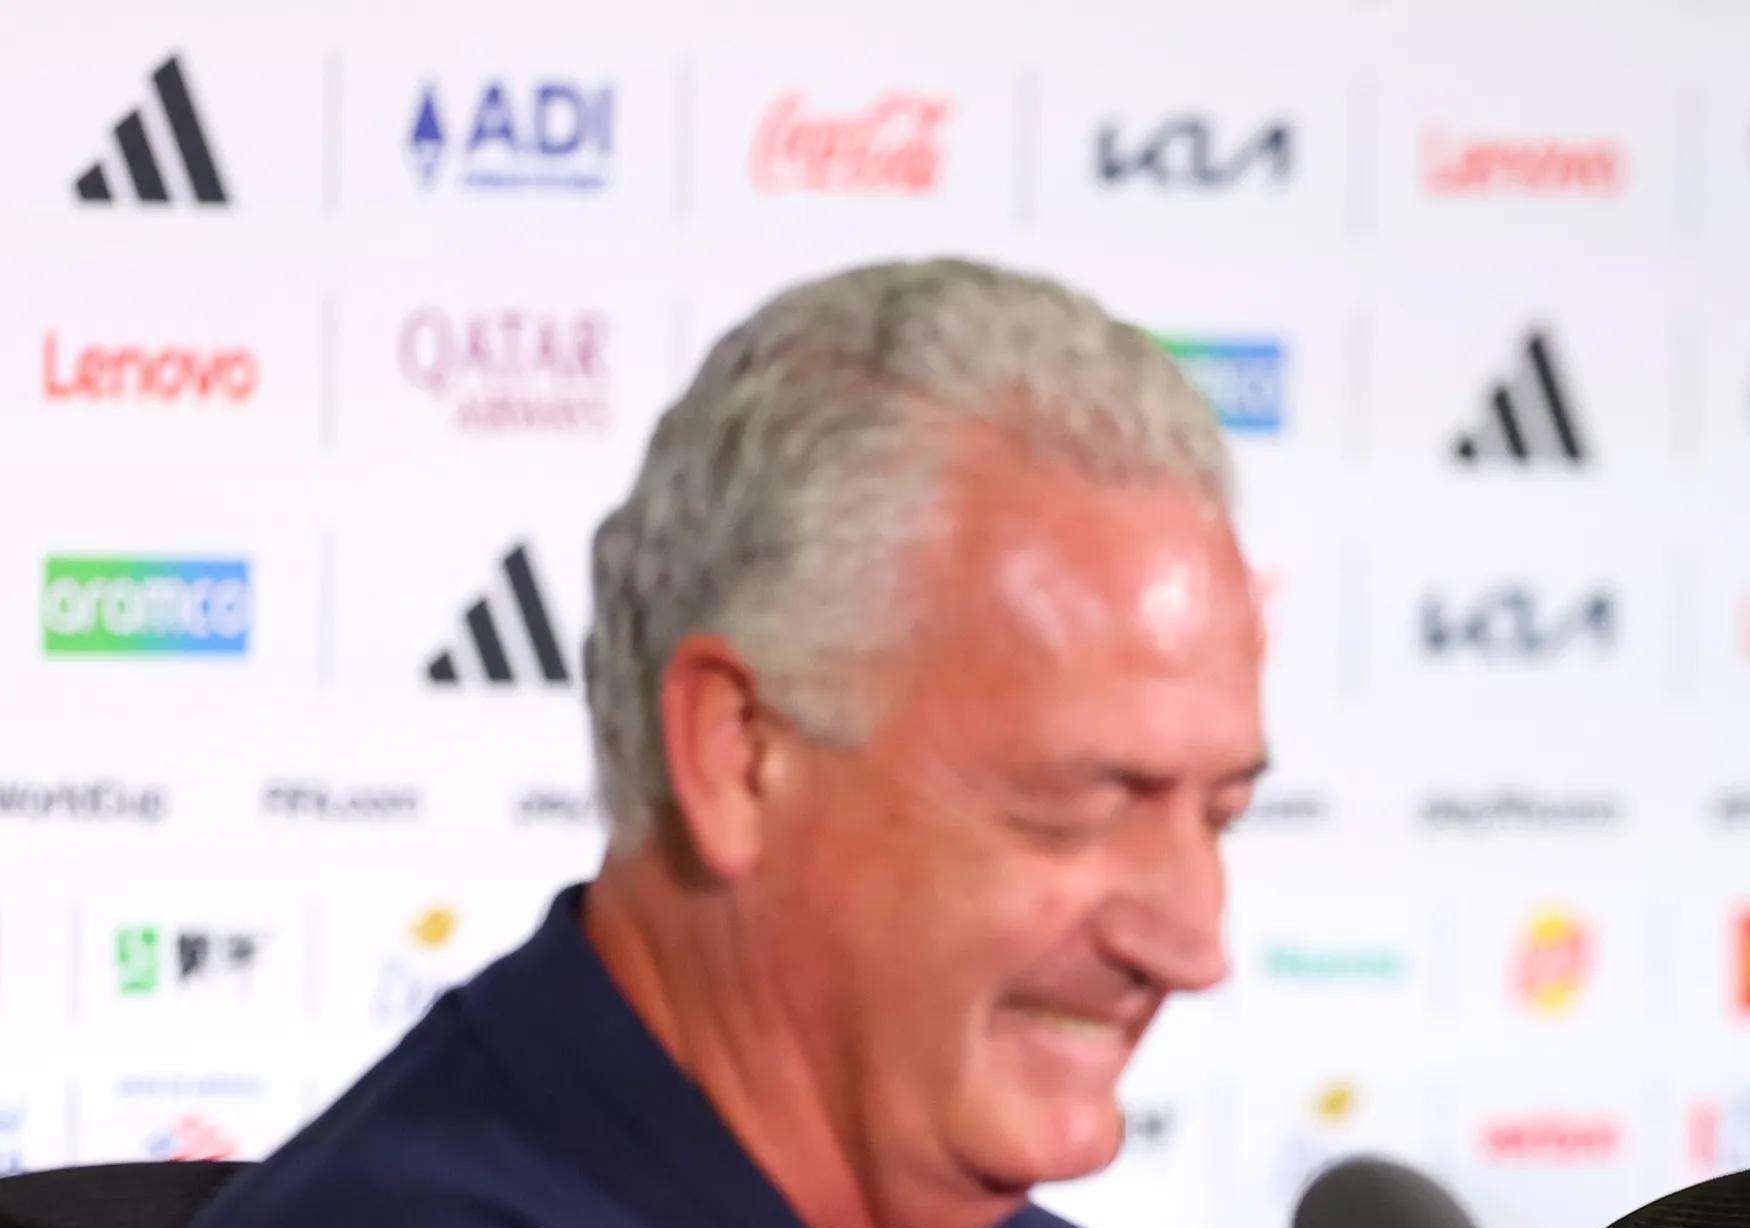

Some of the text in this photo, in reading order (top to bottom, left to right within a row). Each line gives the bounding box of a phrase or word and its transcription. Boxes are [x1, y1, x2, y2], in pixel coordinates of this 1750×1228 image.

[465, 81, 612, 156] ADI
[42, 332, 259, 403] Lenovo
[398, 309, 609, 392] QATAR
